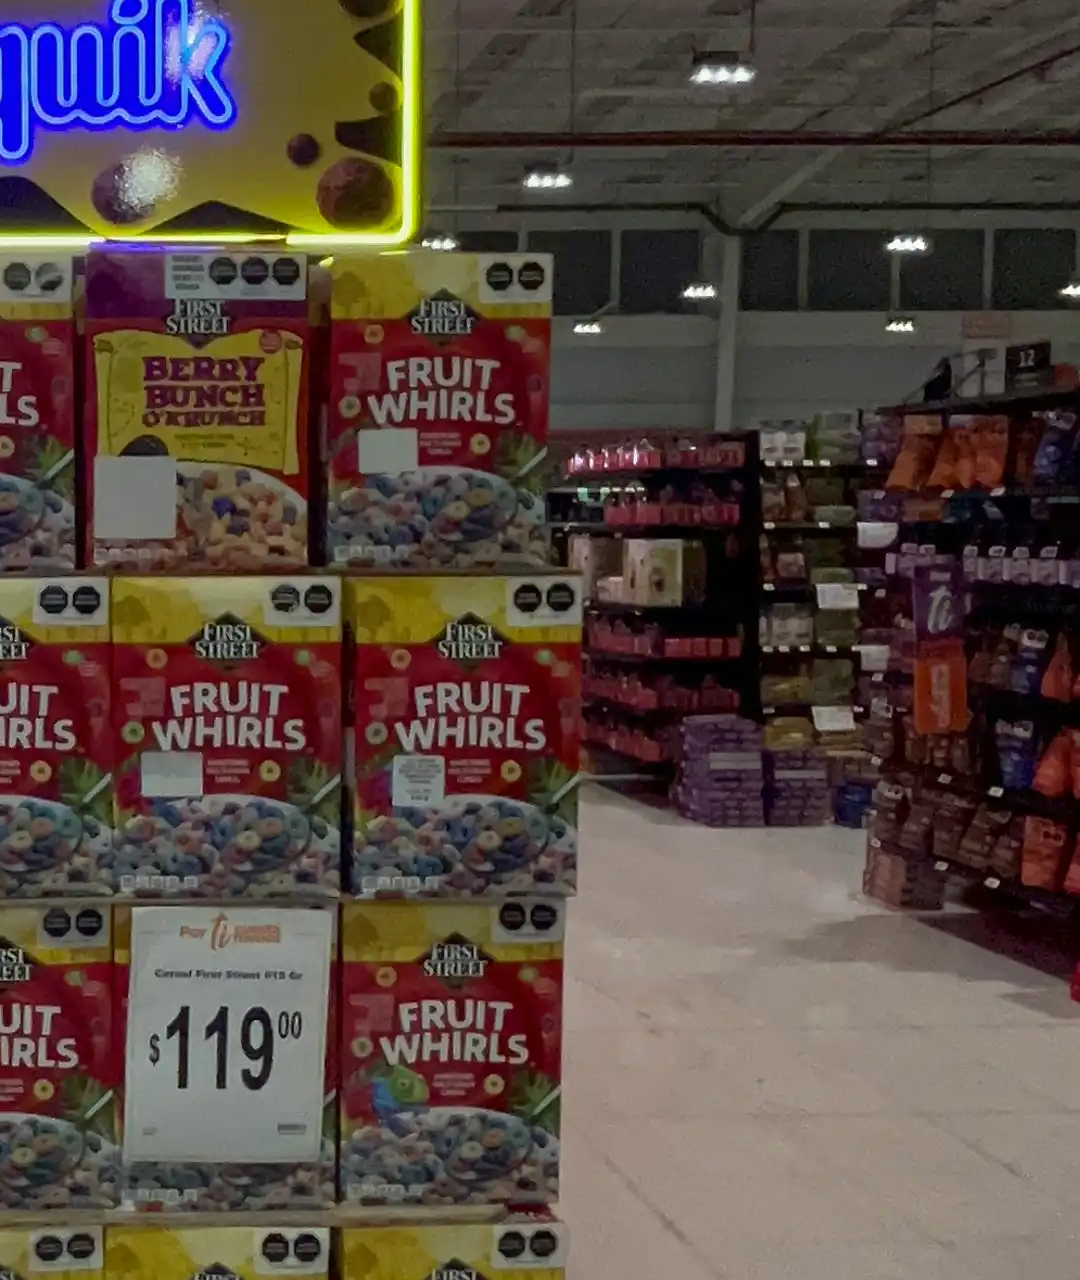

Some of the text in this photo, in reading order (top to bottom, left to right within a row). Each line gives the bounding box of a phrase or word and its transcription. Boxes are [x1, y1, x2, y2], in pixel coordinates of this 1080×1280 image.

[420, 299, 467, 318] FIRST
[142, 357, 265, 381] BERRY
[386, 357, 500, 391] FRUIT
[144, 384, 265, 408] BUNCH
[368, 390, 515, 424] WHIRLS
[203, 622, 251, 642] FIRST
[446, 622, 496, 641] FIRST
[171, 681, 289, 717] FRUIT
[413, 681, 531, 718] FRUIT
[152, 715, 307, 752] WHIRLS
[395, 715, 547, 752] WHIRLS
[432, 943, 480, 961] FIRST
[398, 999, 514, 1033] FRUIT
[379, 1031, 529, 1066] WHIRLS
